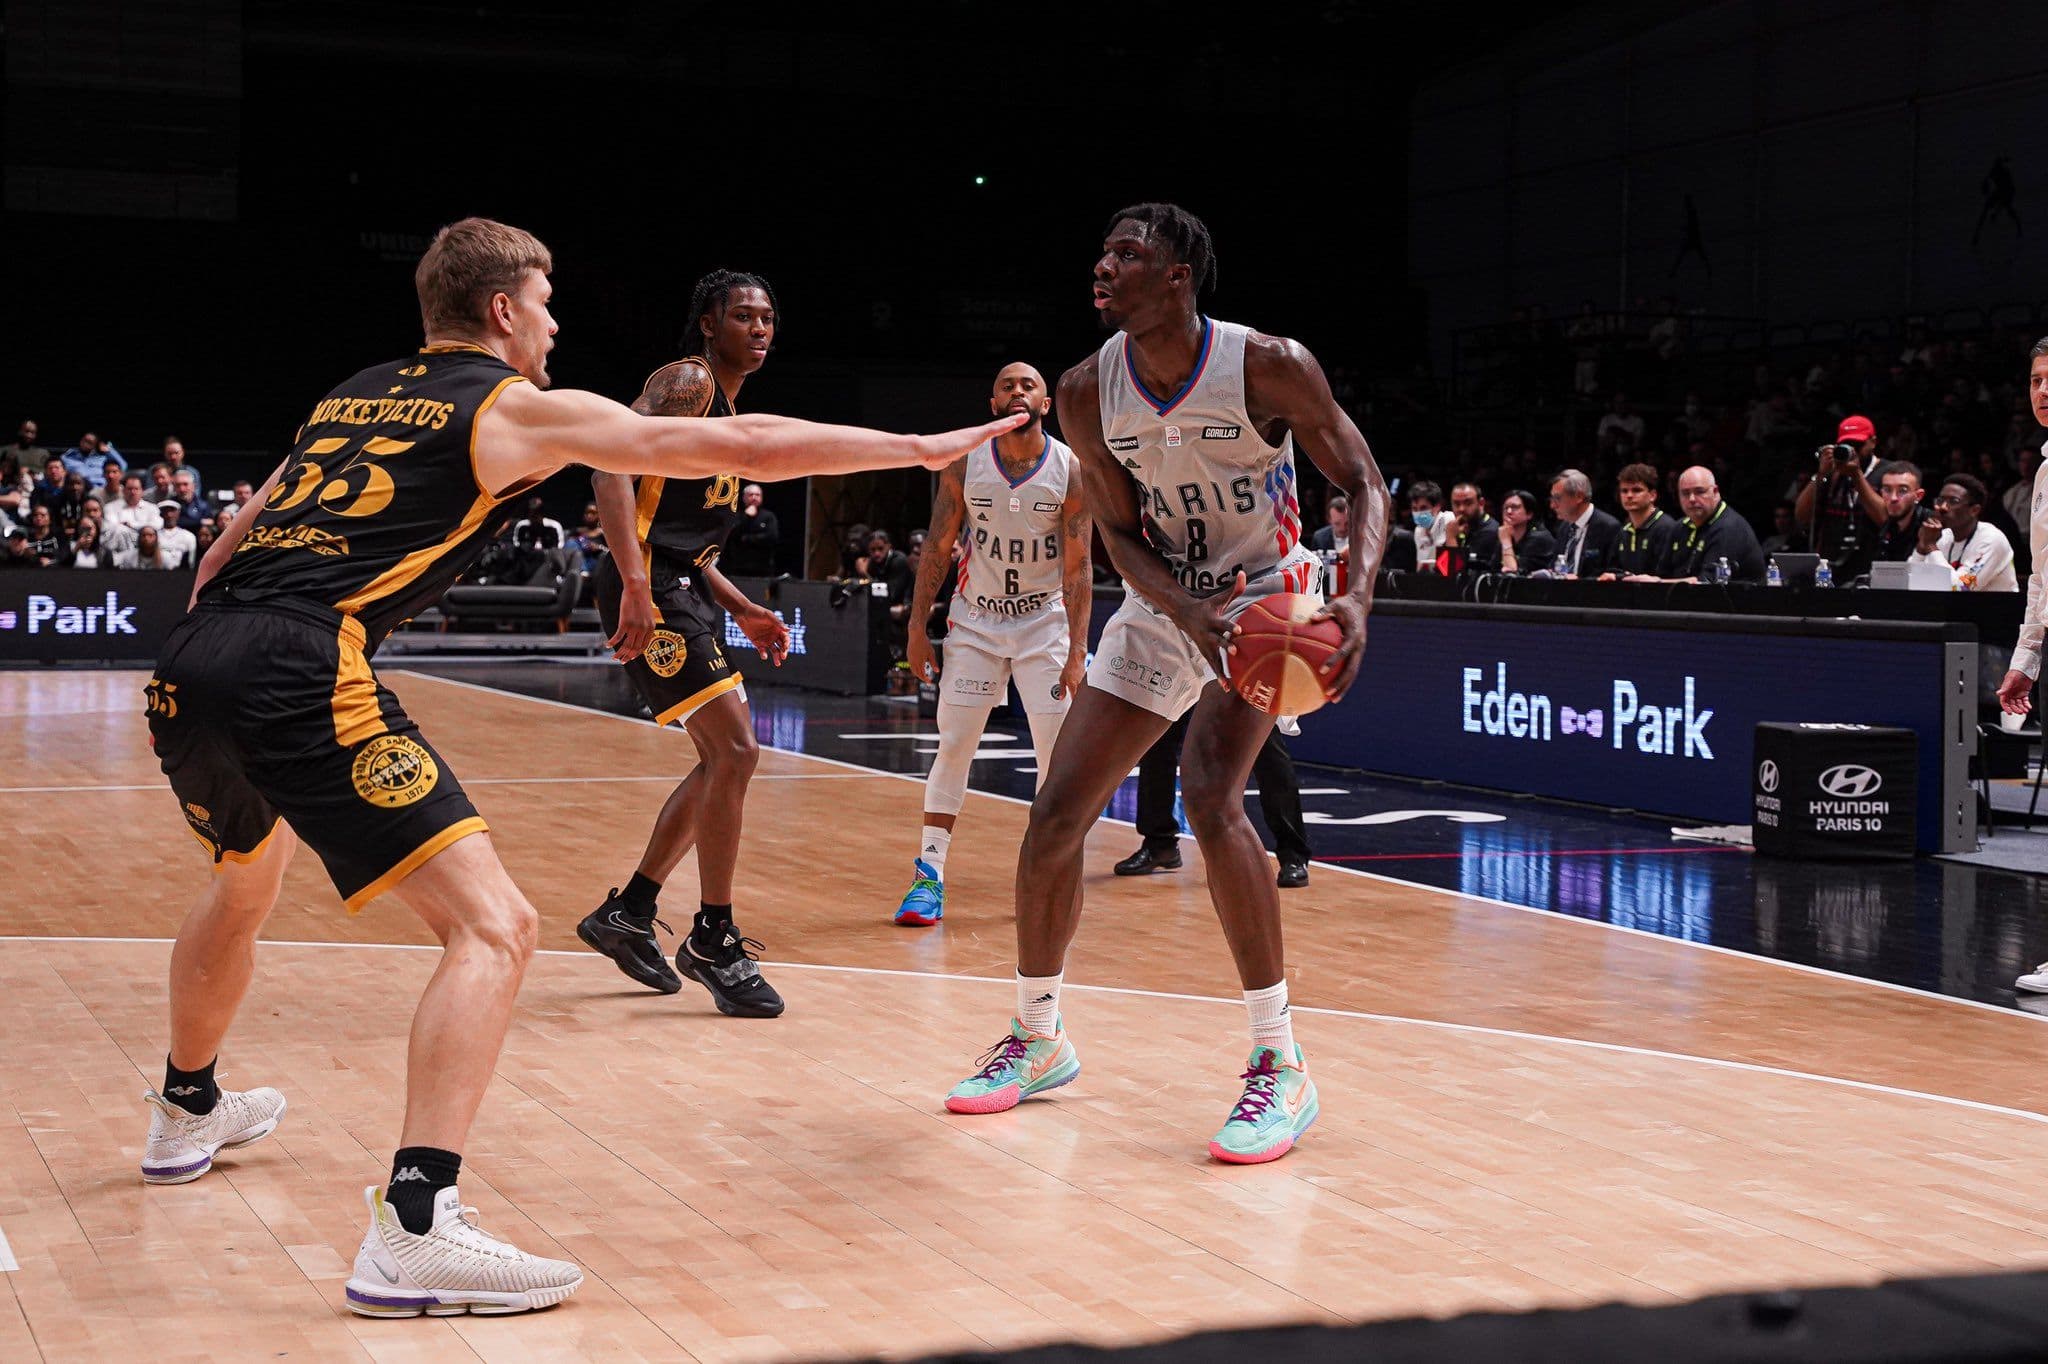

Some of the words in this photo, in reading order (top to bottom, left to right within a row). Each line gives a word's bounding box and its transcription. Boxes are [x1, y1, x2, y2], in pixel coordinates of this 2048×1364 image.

[1205, 428, 1237, 438] GORILLAS
[263, 436, 416, 517] 55
[975, 526, 1059, 563] PARIS
[1186, 518, 1208, 561] 8
[1005, 568, 1019, 595] 6
[27, 591, 137, 634] Park
[1463, 662, 1551, 741] Eden
[1613, 676, 1715, 760] Park
[404, 784, 426, 801] 1972
[1809, 801, 1889, 815] HYUNDAI
[1816, 818, 1862, 831] PARIS
[1866, 818, 1882, 831] 10
